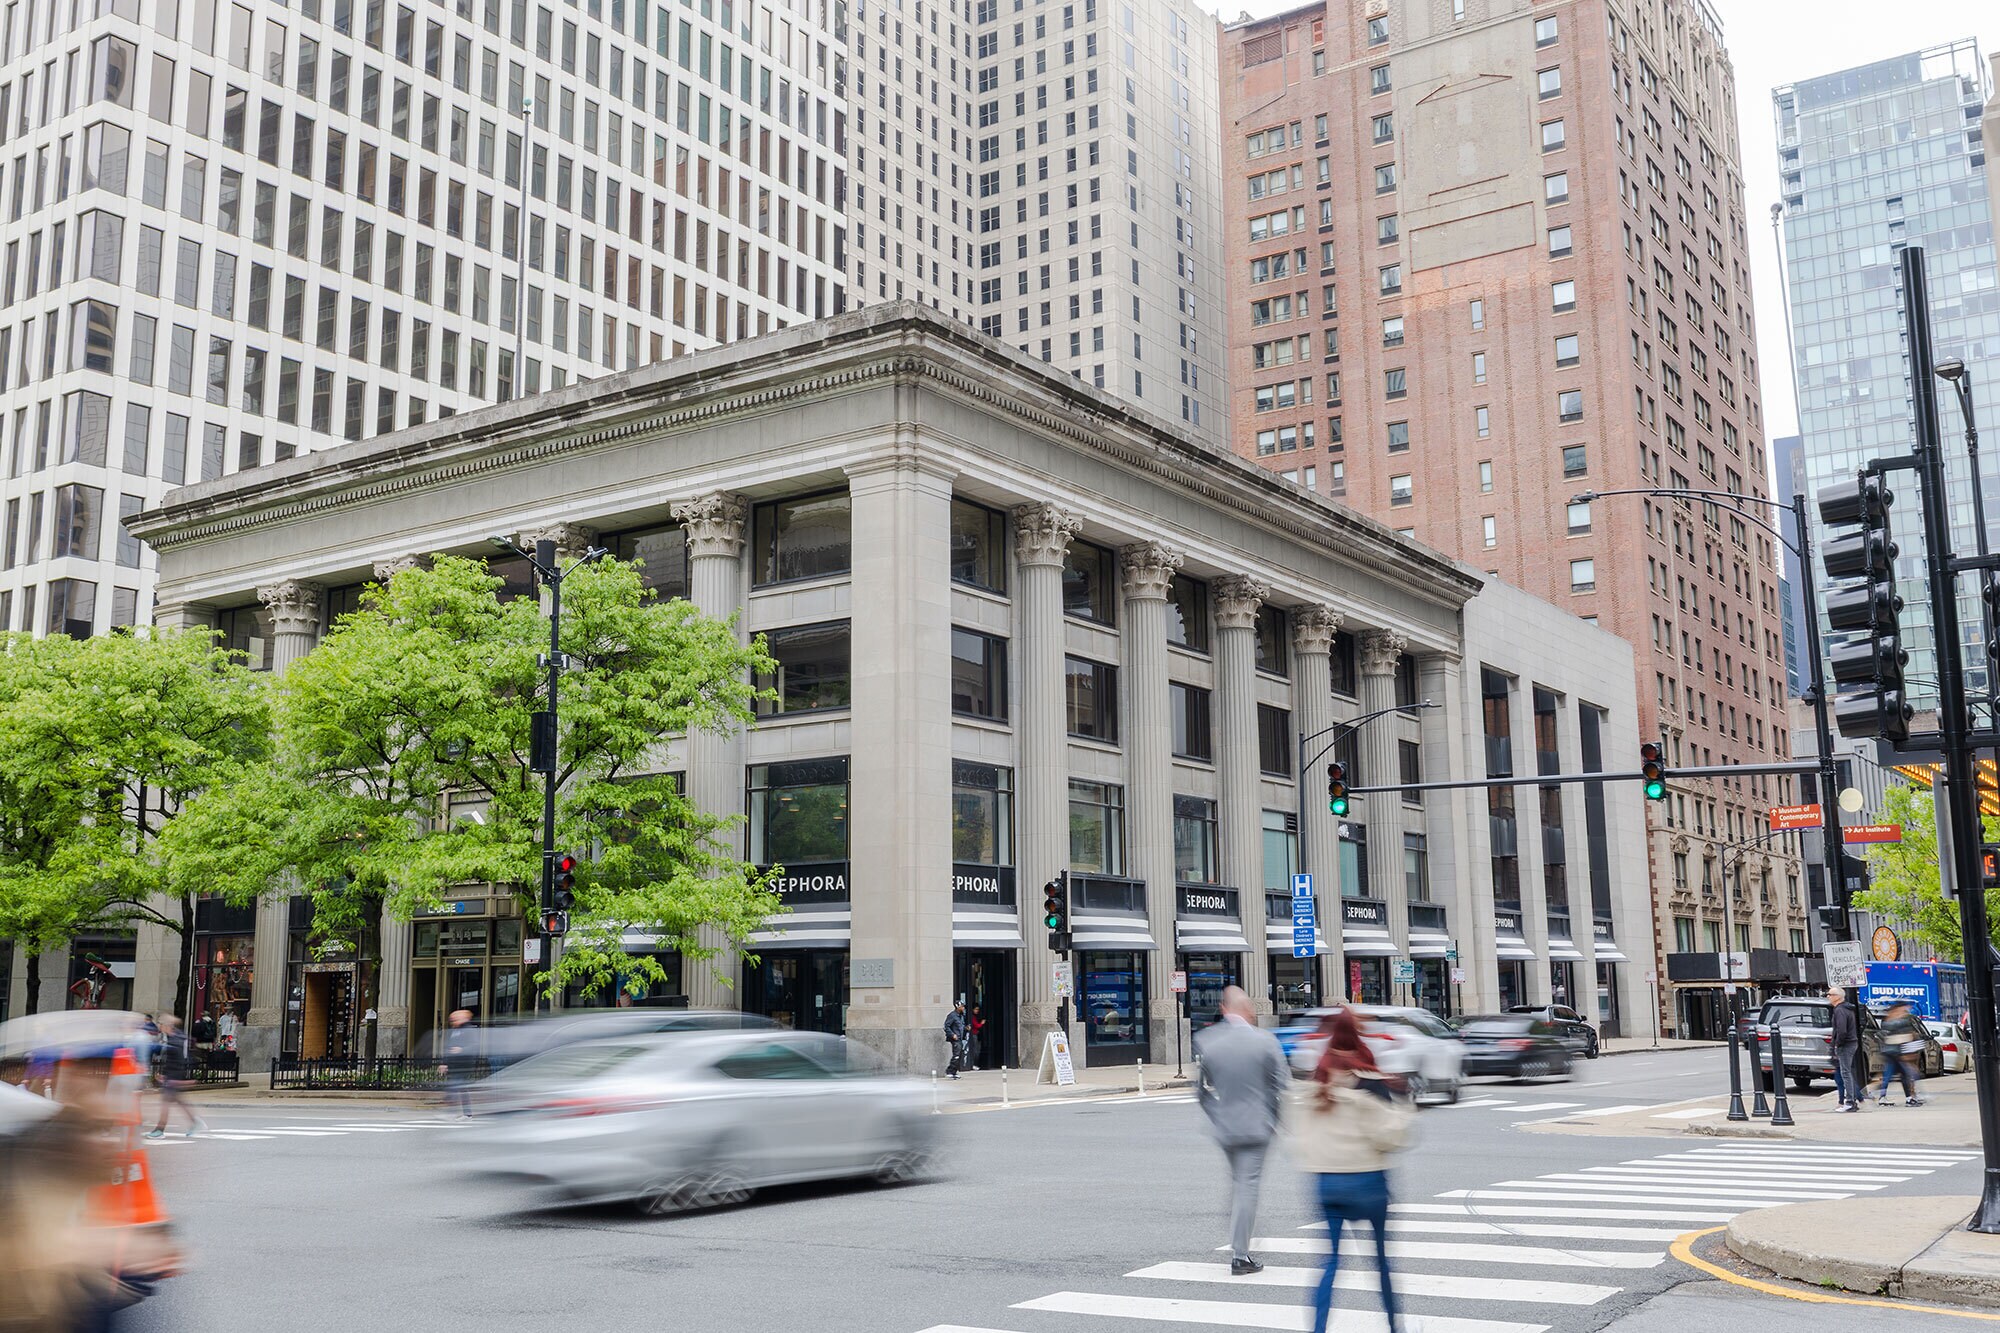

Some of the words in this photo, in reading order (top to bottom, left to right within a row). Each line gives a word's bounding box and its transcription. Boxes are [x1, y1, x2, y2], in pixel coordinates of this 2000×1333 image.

[1779, 807, 1802, 815] Museum
[1779, 812, 1819, 821] Contemporary
[769, 875, 846, 893] SEPHORA
[952, 875, 998, 893] EPHORA
[1294, 875, 1311, 896] H
[1186, 894, 1226, 909] SEPHORA
[1347, 906, 1377, 919] SEPHORA
[1495, 917, 1514, 928] EPHORA
[1872, 987, 1894, 995] BUD
[1895, 987, 1925, 996] LIGHT
